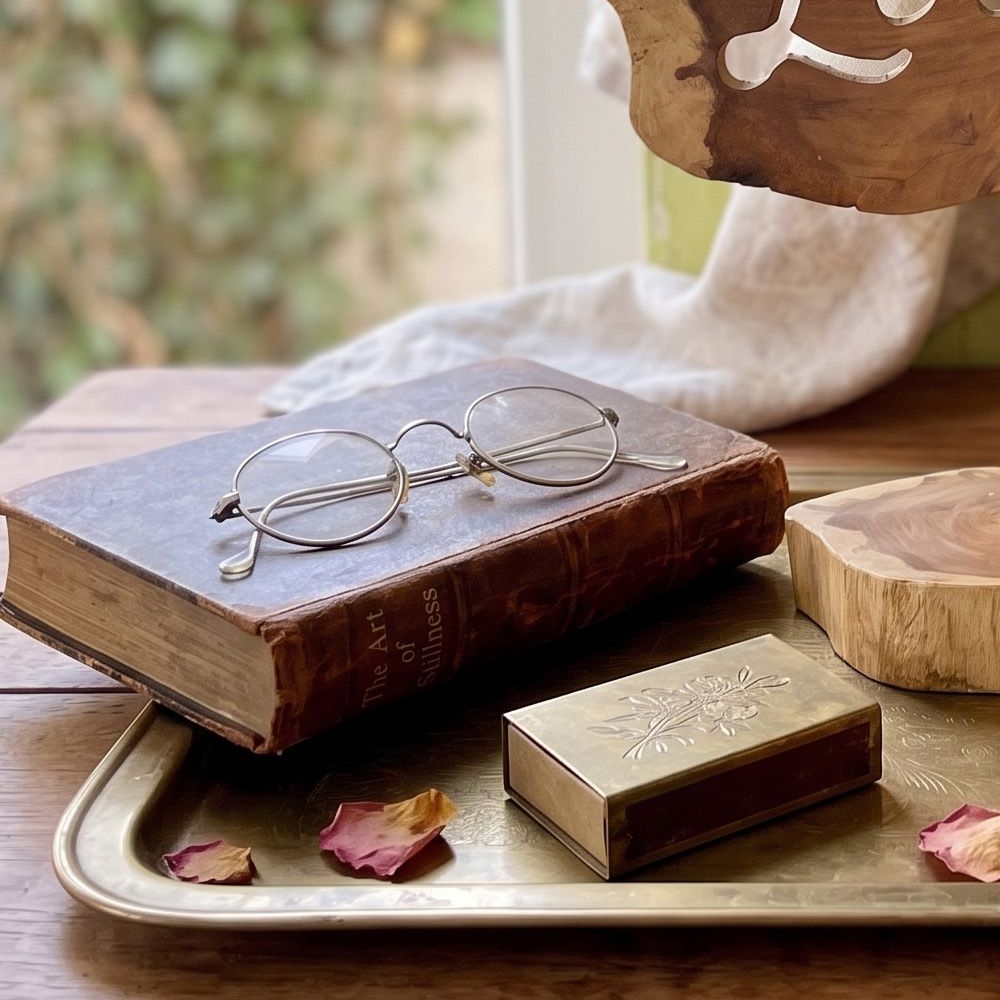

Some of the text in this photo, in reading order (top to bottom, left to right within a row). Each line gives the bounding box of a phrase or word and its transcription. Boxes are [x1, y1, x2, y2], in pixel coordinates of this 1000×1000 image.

[361, 608, 388, 708] The Art
[395, 641, 415, 663] of
[417, 588, 443, 687] Stillness
